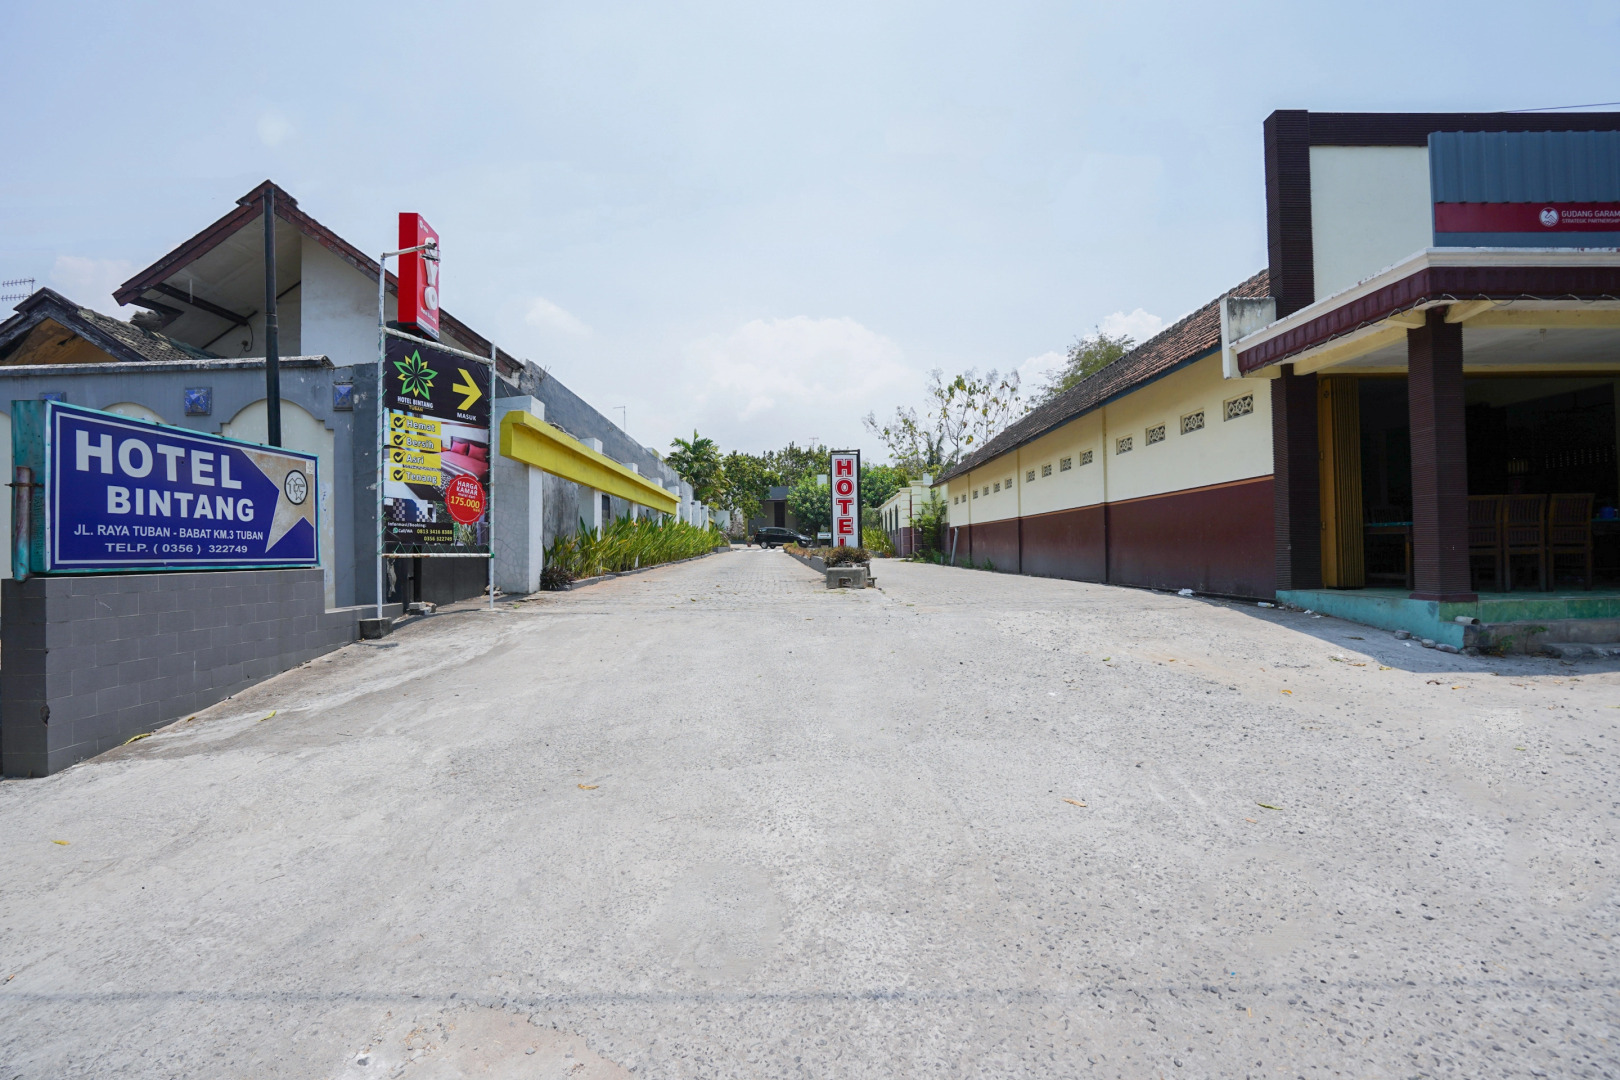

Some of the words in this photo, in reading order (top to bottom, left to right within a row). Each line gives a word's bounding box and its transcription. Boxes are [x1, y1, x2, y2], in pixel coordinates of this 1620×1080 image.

[1561, 210, 1593, 218] GUDANG
[397, 395, 412, 405] HOTEL
[412, 398, 434, 409] BINTANG
[456, 412, 477, 422] MASUK
[406, 419, 436, 432] Hemat
[406, 436, 434, 449] Bersih
[75, 429, 243, 490] HOTEL
[405, 454, 424, 464] Asri
[405, 471, 437, 484] Tenang
[456, 486, 478, 496] KAMAR
[457, 480, 478, 490] HARGA
[106, 485, 255, 523] BINTANG
[450, 495, 480, 509] 175.000
[73, 523, 94, 537] JL.
[97, 524, 130, 538] RAYA
[132, 525, 171, 539] TUBAN
[179, 527, 212, 540] BABAT
[213, 529, 235, 541] KM.3
[235, 530, 264, 541] TUBAN
[105, 543, 149, 554] TELP.
[208, 544, 248, 555] 322749
